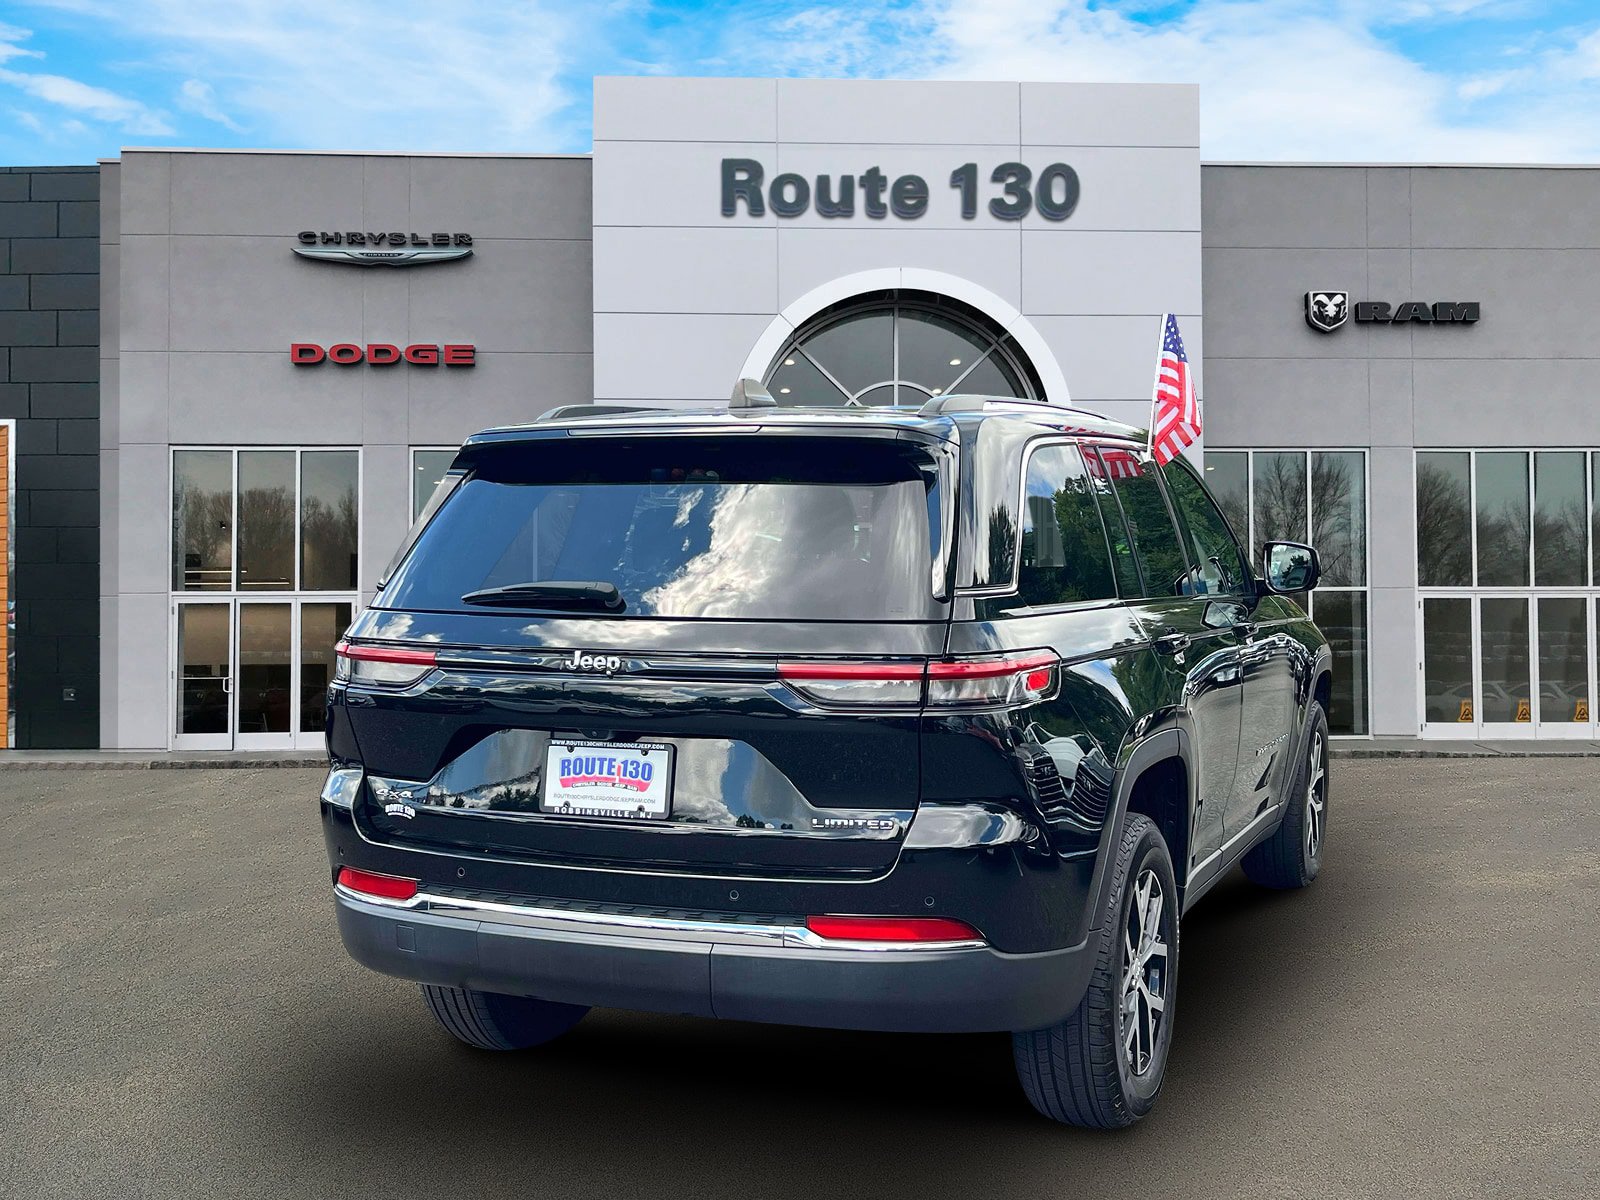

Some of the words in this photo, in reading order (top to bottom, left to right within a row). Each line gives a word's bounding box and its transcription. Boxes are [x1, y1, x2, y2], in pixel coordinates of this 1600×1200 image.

[721, 158, 929, 219] Route
[950, 162, 1080, 221] 130
[298, 231, 473, 245] CHRYSLER
[1355, 302, 1480, 323] RAM
[291, 343, 476, 366] DODGE
[565, 650, 621, 675] Jeep
[560, 757, 617, 777] ROUTE
[620, 759, 653, 781] 130
[553, 806, 635, 819] ROBBINSVILLE,
[812, 818, 894, 830] LIMITED
